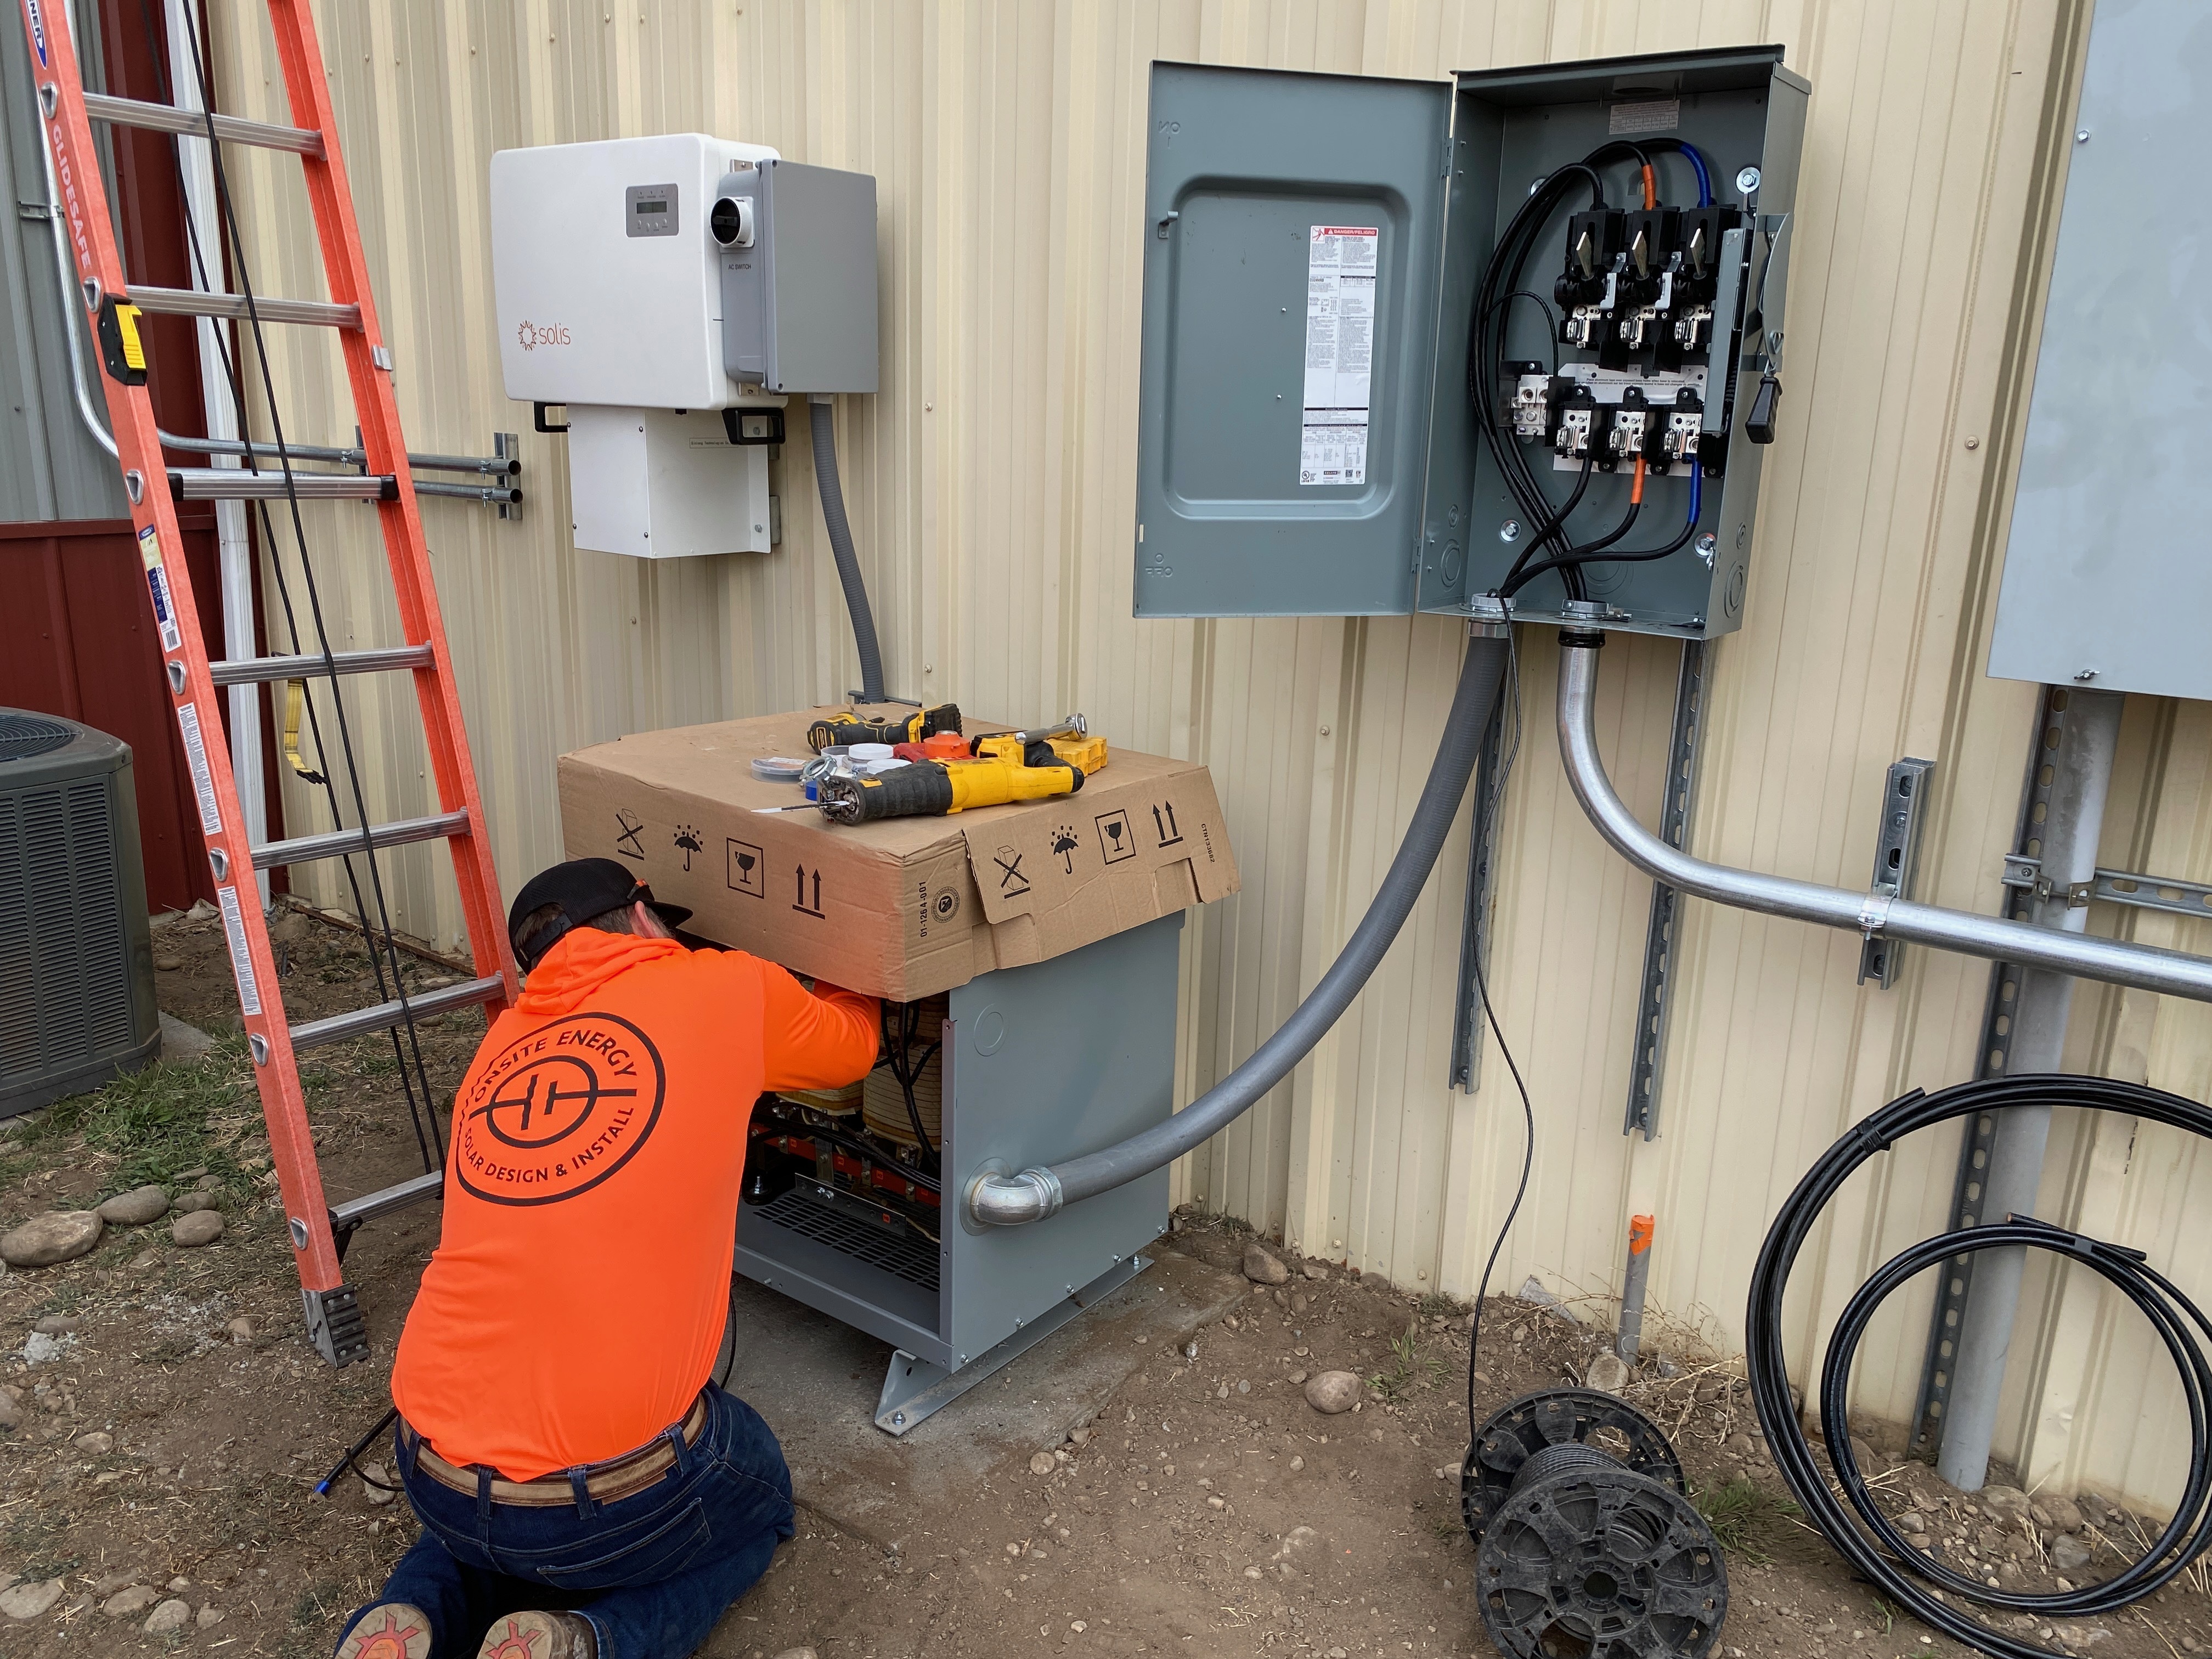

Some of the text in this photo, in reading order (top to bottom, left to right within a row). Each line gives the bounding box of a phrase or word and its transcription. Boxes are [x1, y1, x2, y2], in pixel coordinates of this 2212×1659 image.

[29, 0, 42, 39] NER
[53, 125, 92, 269] GLIDESAFE
[539, 322, 571, 345] solis
[919, 881, 928, 938] 01-1264-001
[475, 1030, 637, 1102] ONSITE ENERGY
[465, 1108, 634, 1183] SOLAR DESIGN & INSTALL
